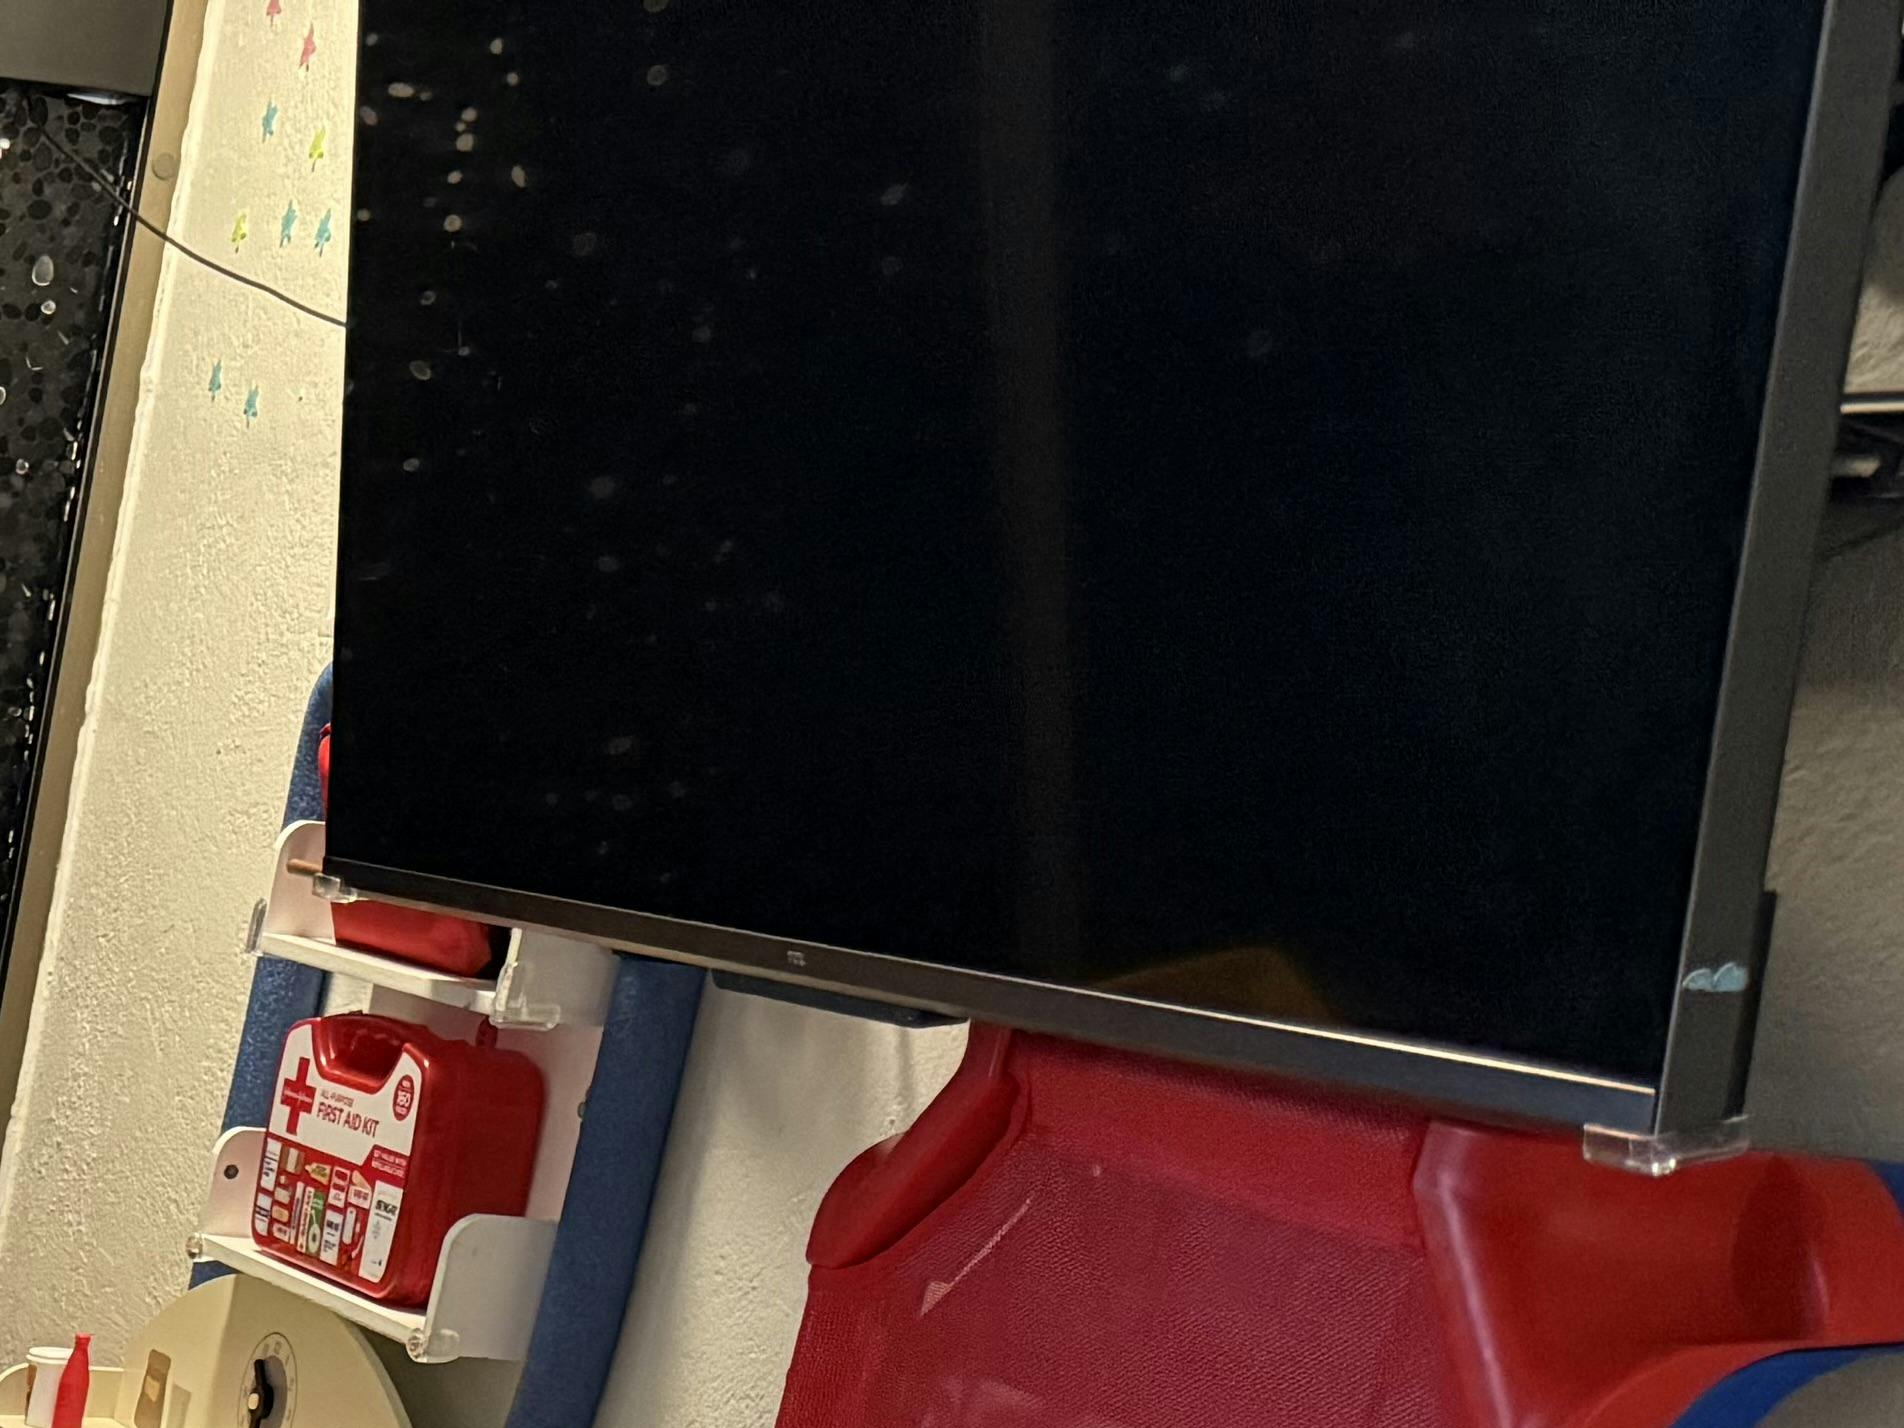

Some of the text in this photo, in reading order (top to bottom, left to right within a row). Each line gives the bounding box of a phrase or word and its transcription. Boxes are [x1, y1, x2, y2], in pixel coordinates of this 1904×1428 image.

[317, 1101, 380, 1138] FIRST AID KIT
